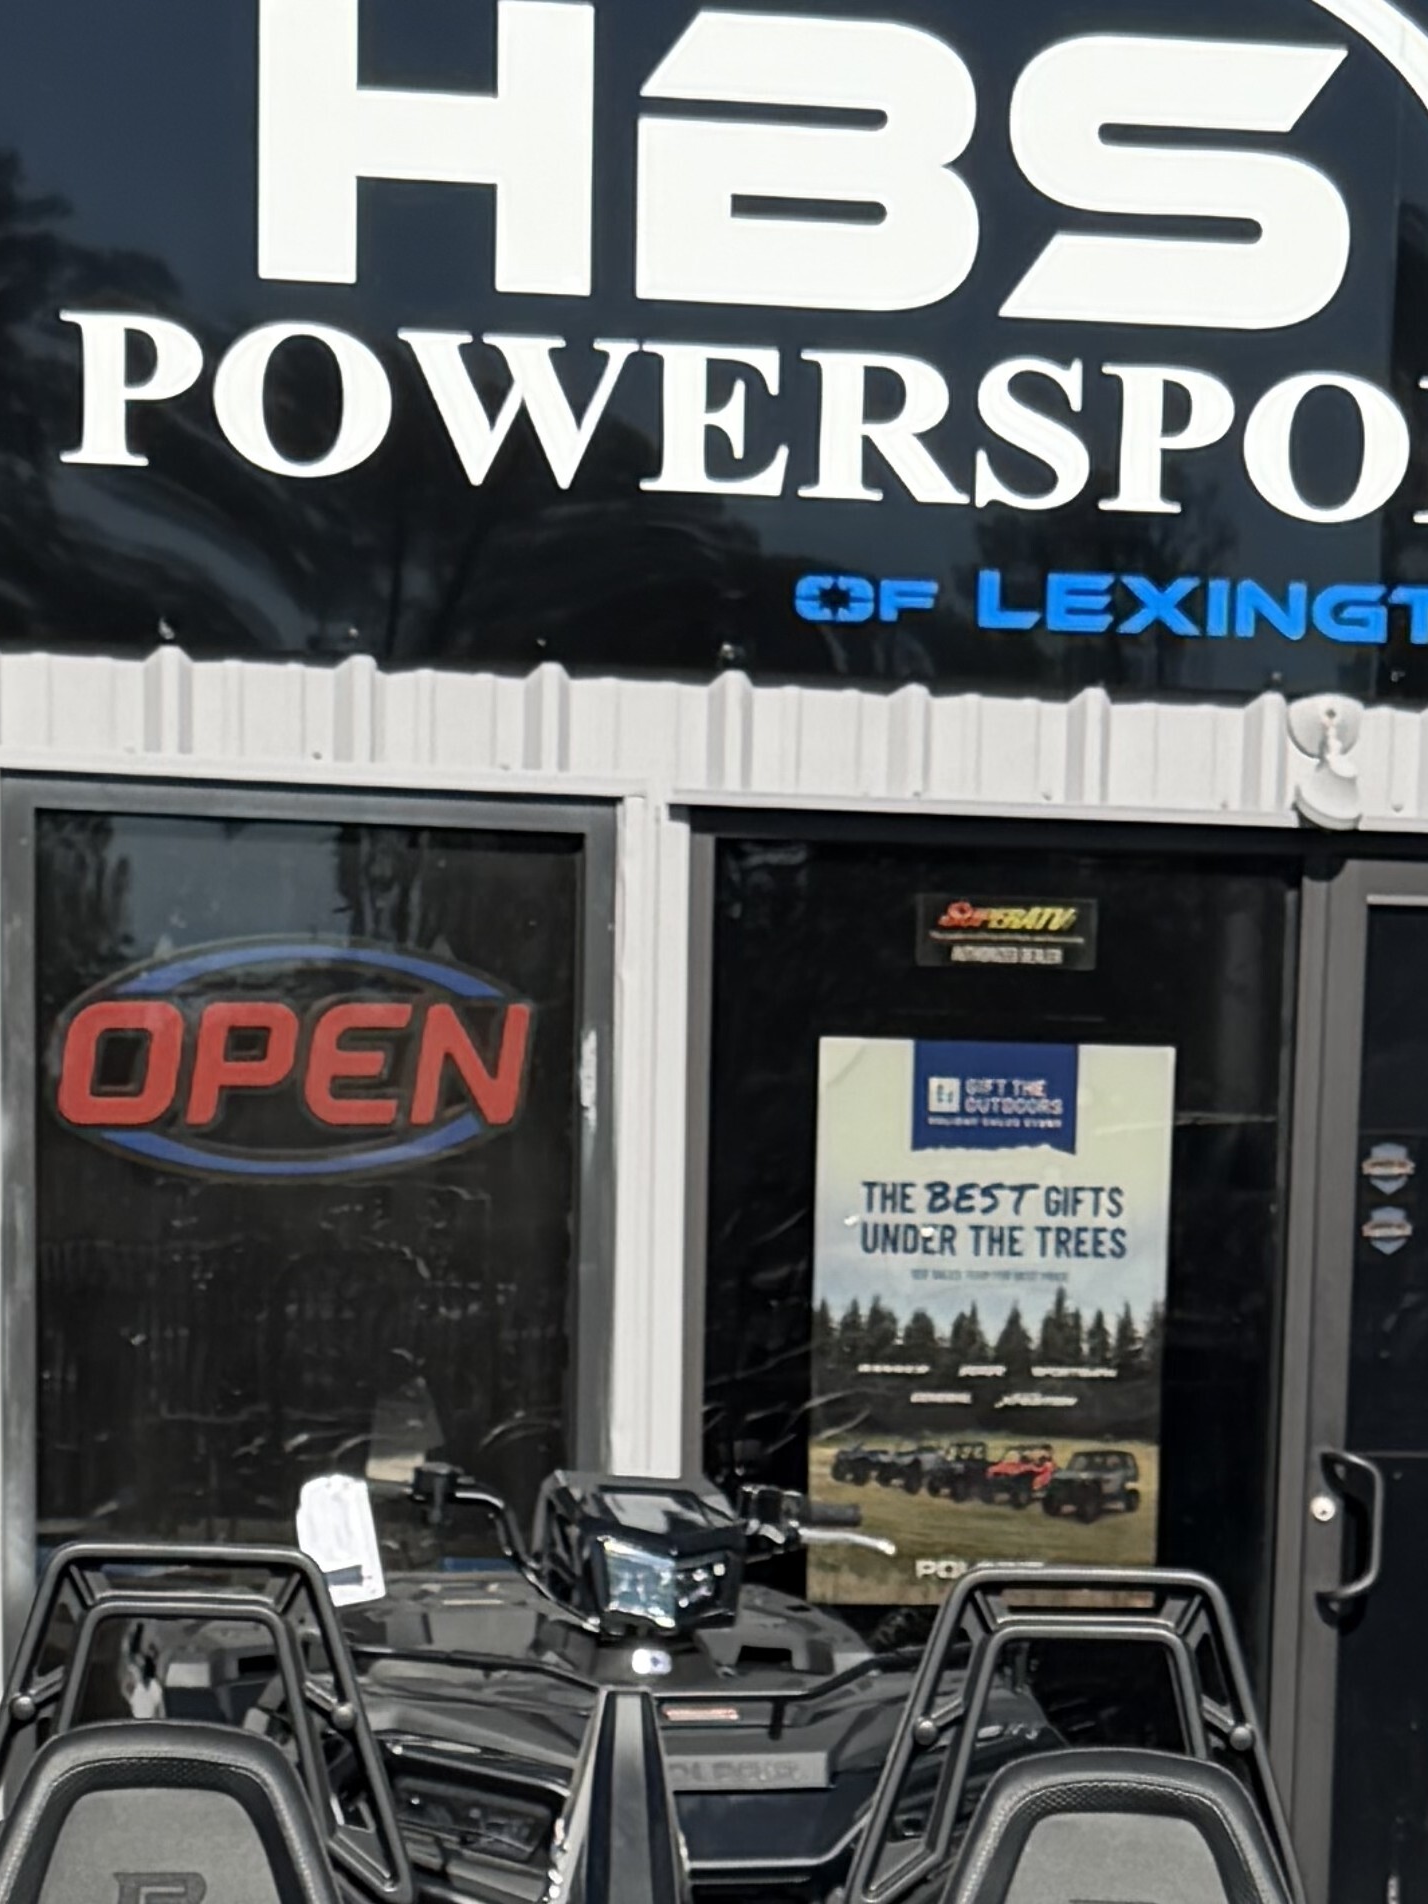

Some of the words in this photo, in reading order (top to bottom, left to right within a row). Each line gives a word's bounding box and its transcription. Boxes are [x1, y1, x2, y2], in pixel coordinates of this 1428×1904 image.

[257, 0, 1350, 329] HBS
[796, 576, 936, 621] OF
[59, 1003, 528, 1123] OPEN
[964, 1097, 1063, 1115] OUTDOORS
[965, 1078, 1007, 1096] GIFT
[1011, 1079, 1047, 1098] THE
[863, 1181, 915, 1214] THE
[925, 1181, 1040, 1216] BEST
[1044, 1186, 1124, 1218] GIFTS
[861, 1223, 956, 1256] UNDER
[970, 1225, 1024, 1257] THE
[1037, 1226, 1127, 1258] TREES
